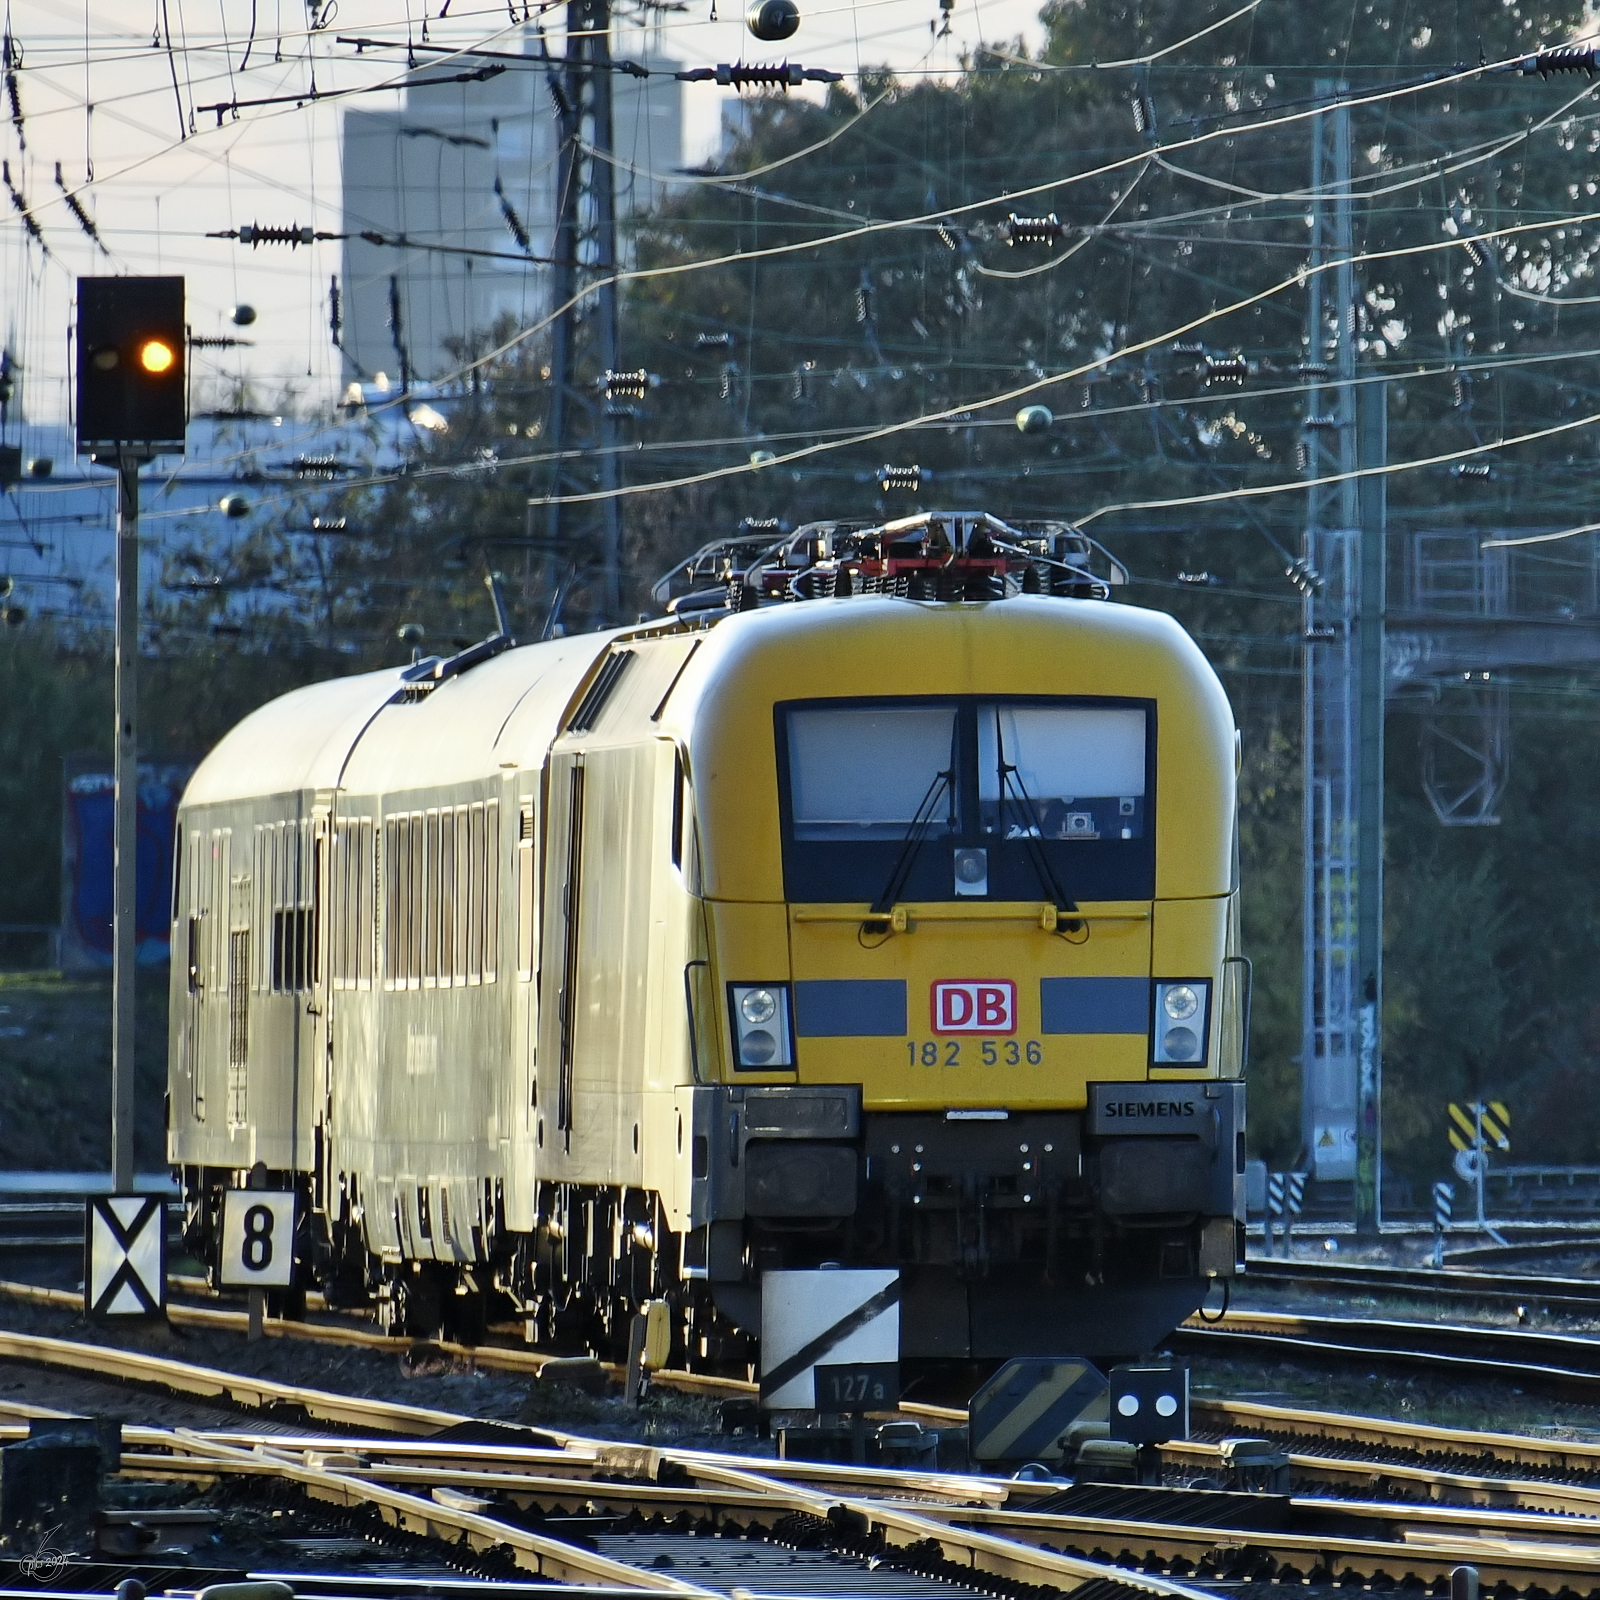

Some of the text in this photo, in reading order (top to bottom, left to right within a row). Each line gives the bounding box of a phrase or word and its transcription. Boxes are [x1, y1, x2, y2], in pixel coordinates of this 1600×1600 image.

[942, 988, 1007, 1026] DB
[907, 1040, 1042, 1067] 182 536
[1105, 1101, 1195, 1118] SIEMENS
[242, 1204, 275, 1272] 8
